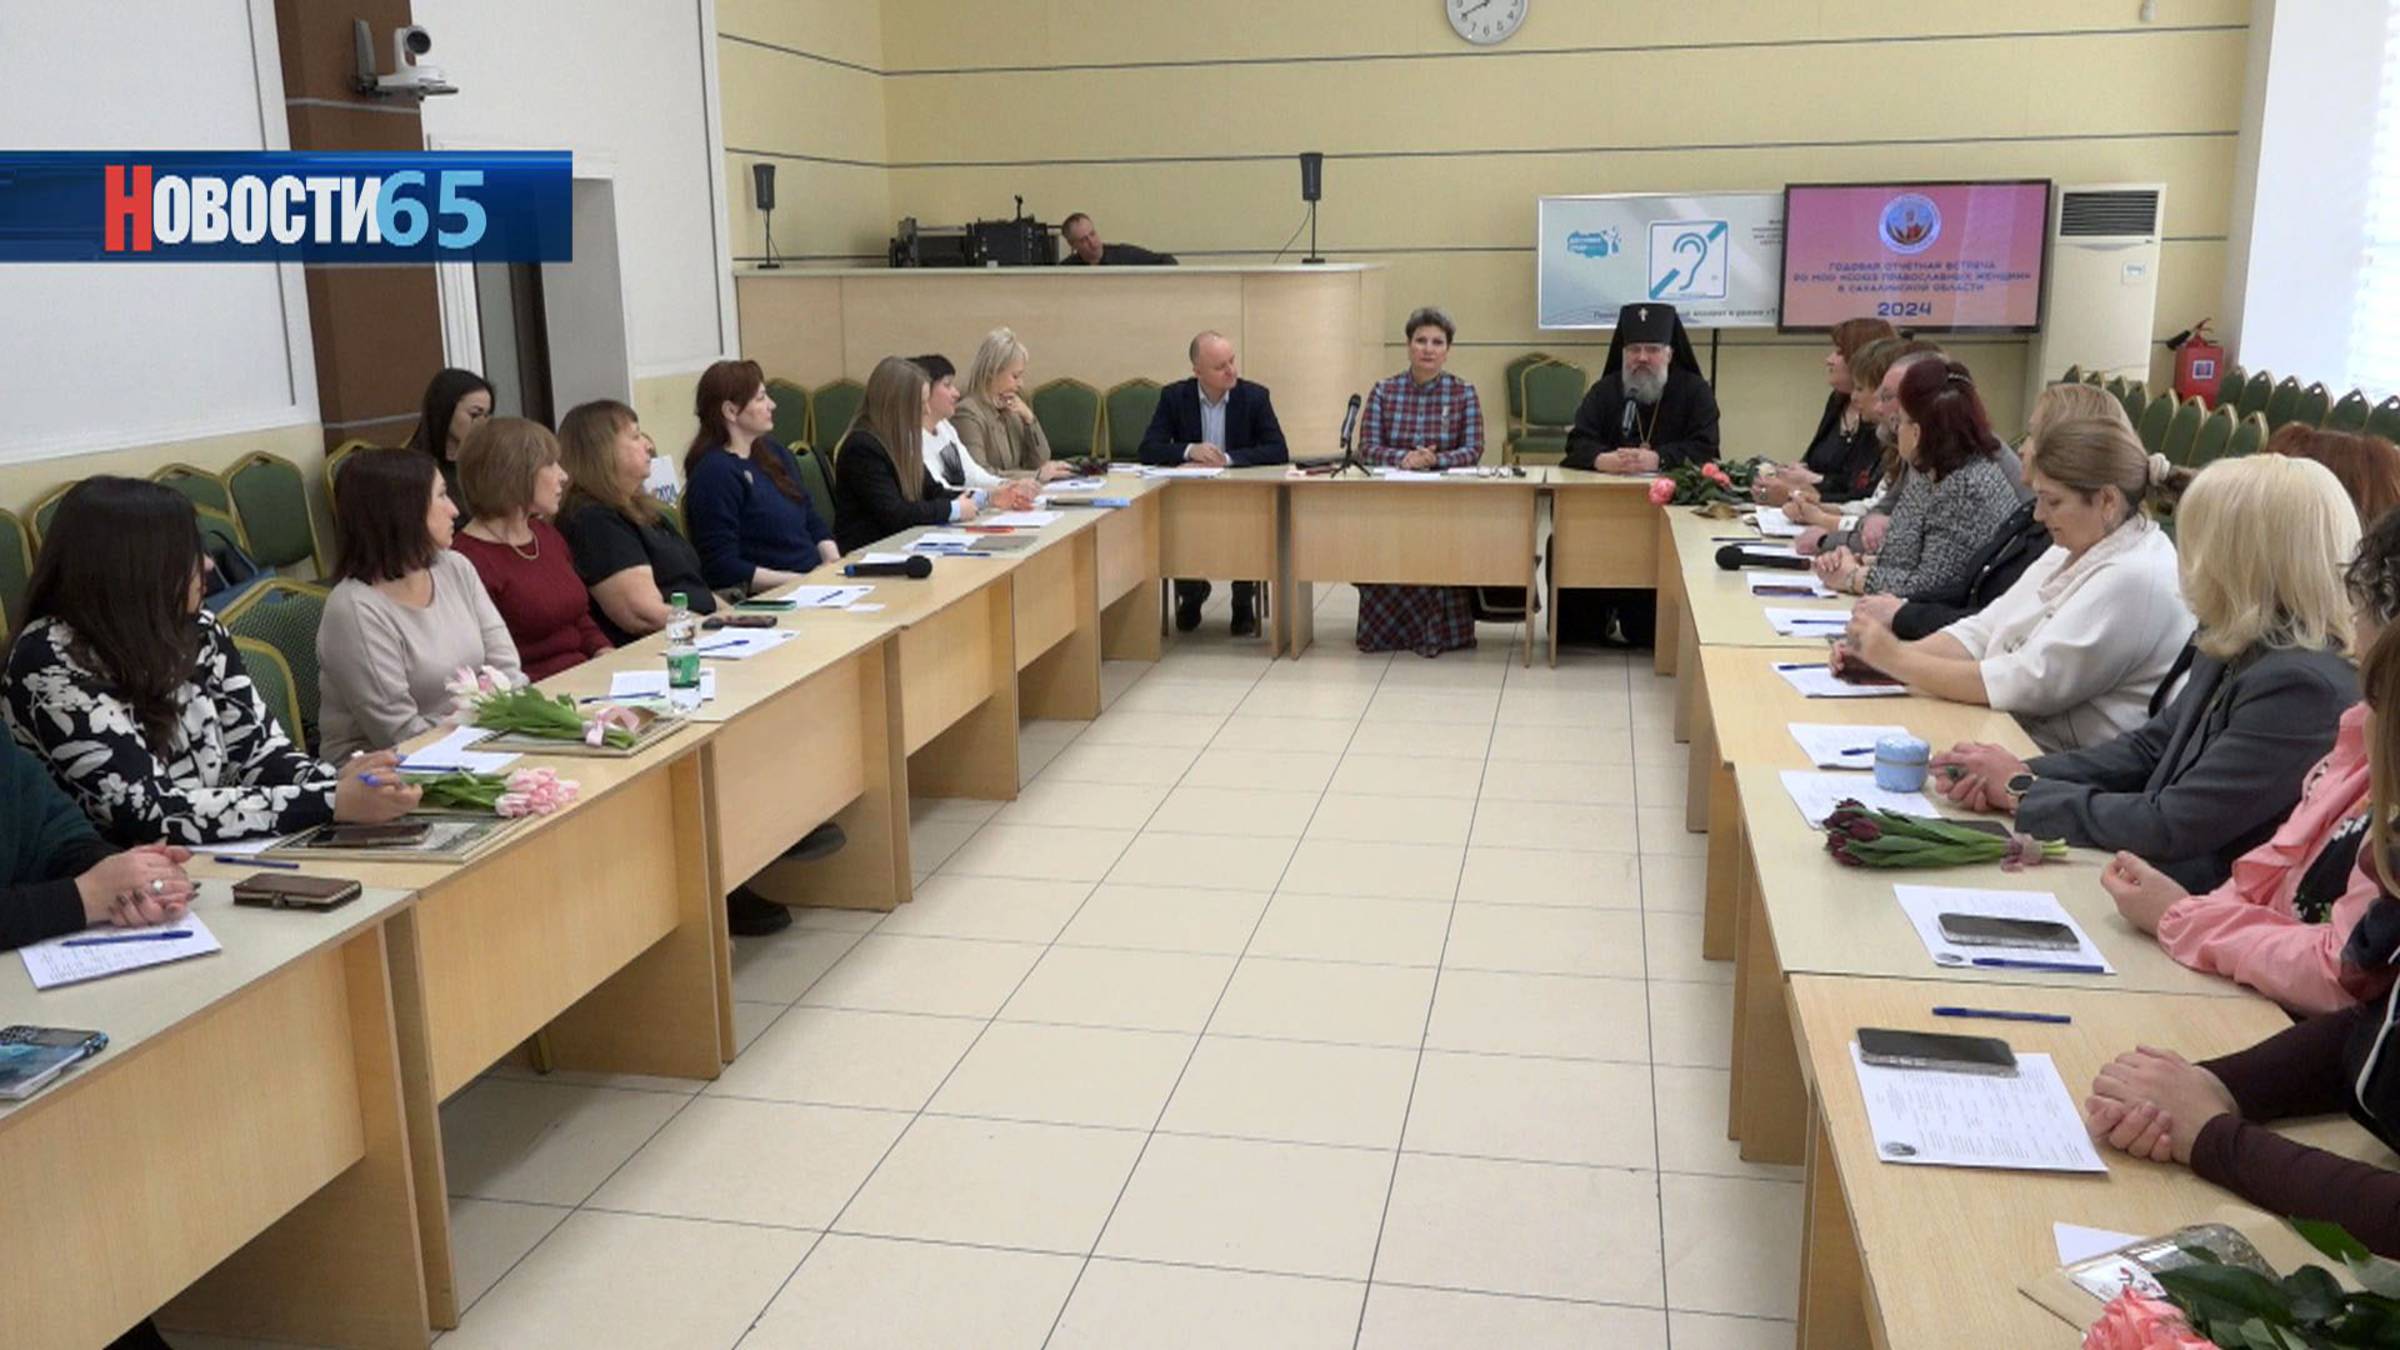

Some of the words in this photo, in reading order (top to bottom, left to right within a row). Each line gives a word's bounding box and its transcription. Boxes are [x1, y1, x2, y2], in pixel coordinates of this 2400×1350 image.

[1828, 262, 1881, 272] ГОДОВАЯ
[1881, 272, 1972, 282] ПРАВОСЛАВНЫХ
[1850, 283, 1929, 293] САХАЛИНСКОЙ
[1933, 282, 1985, 292] ОБЛАСТИ
[1877, 302, 1932, 317] 2024
